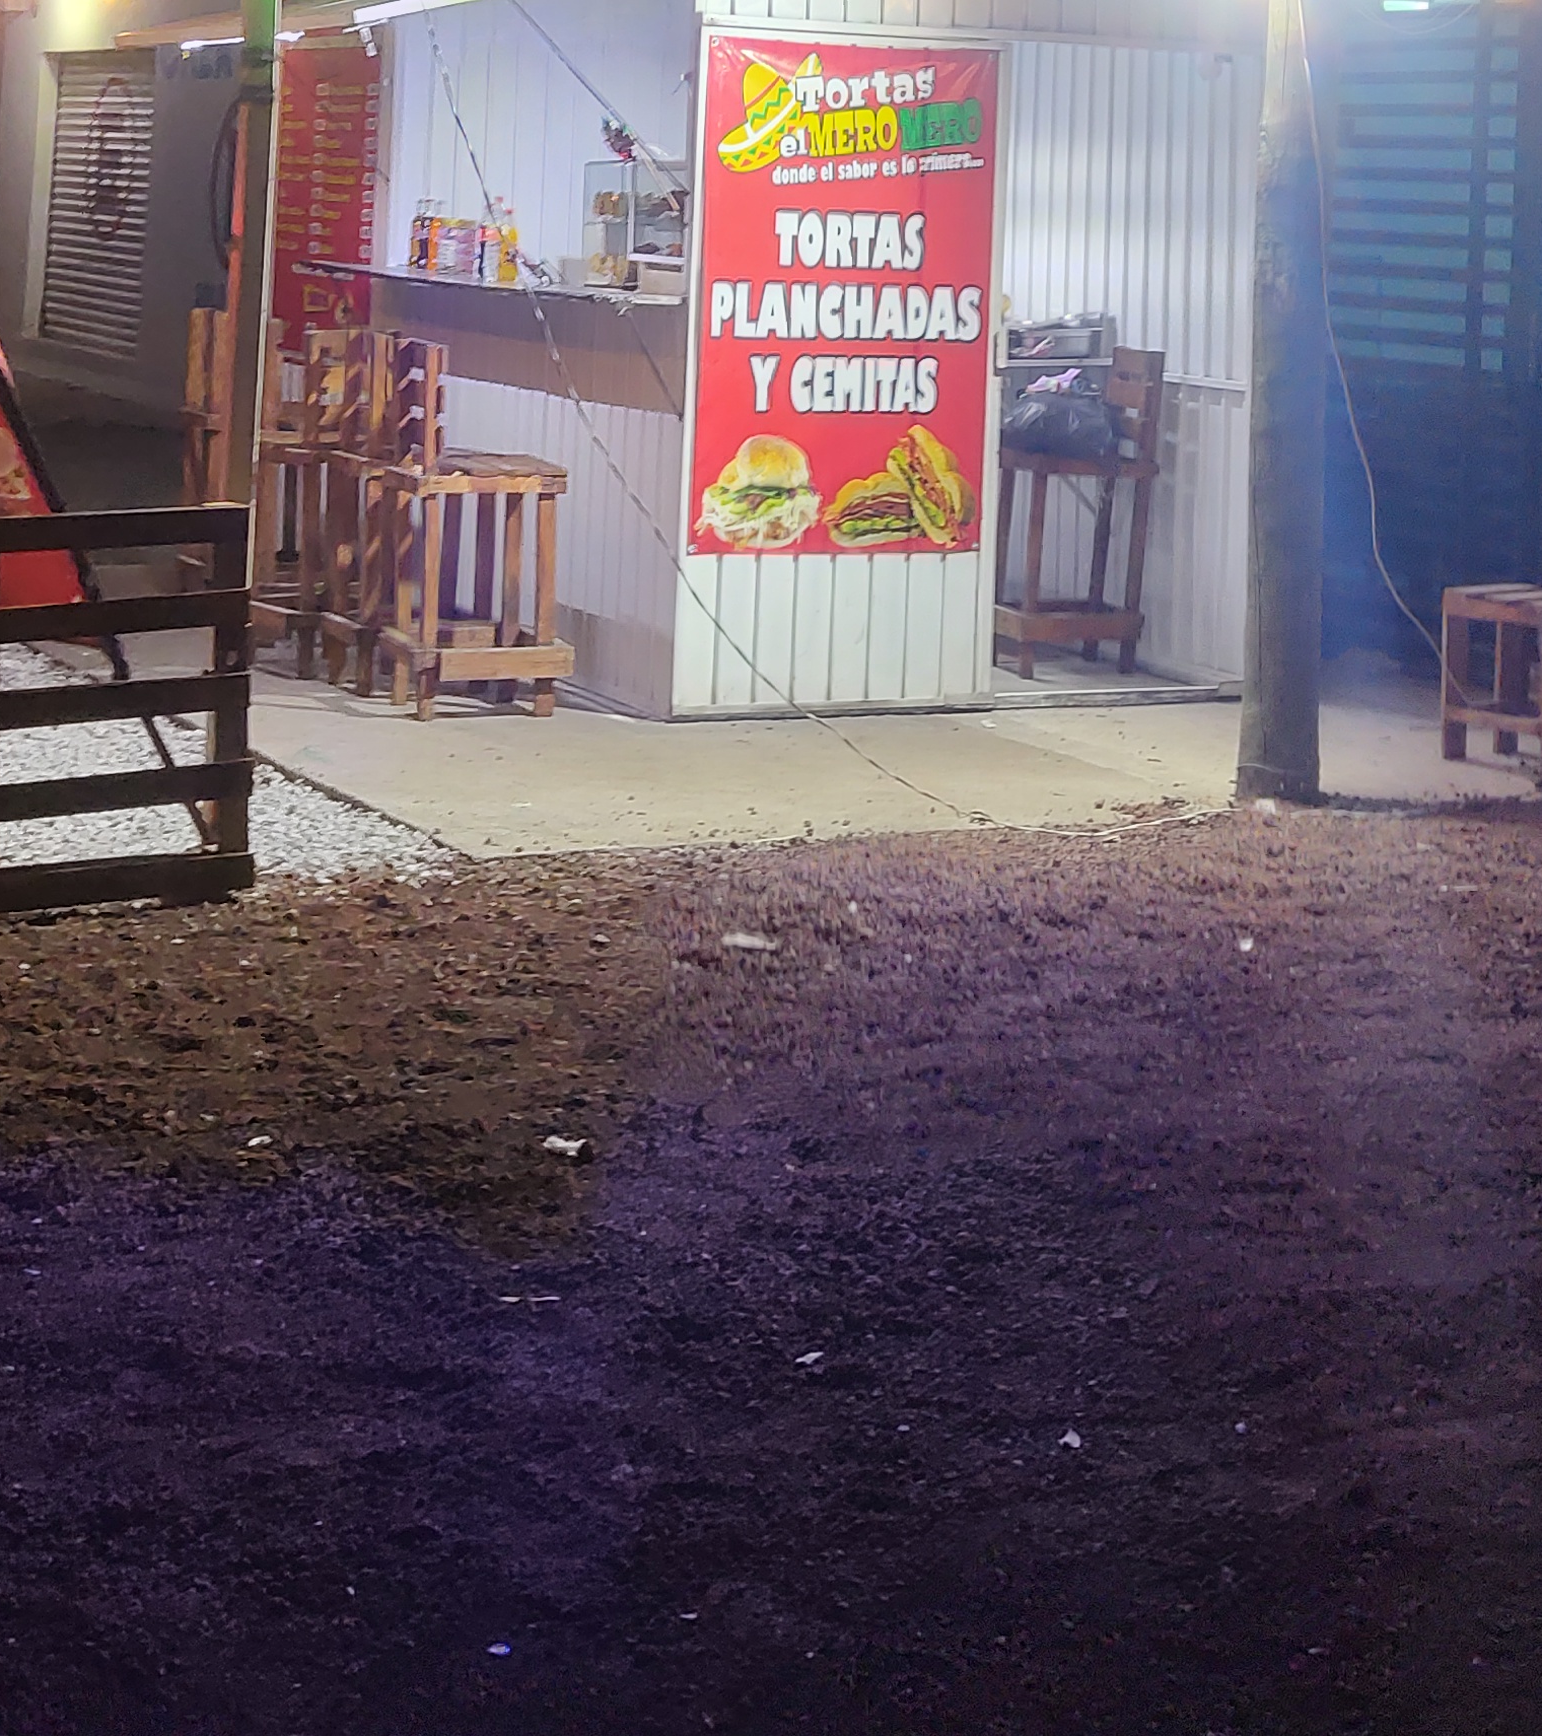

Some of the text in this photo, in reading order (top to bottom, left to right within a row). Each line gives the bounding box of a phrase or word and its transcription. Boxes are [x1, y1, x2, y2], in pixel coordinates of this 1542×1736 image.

[795, 66, 936, 113] Tortas
[779, 97, 984, 158] el MERO MERO
[771, 164, 818, 186] donde
[820, 162, 835, 182] el
[837, 158, 878, 181] sabor
[881, 158, 899, 177] es
[901, 154, 916, 175] lo
[774, 209, 926, 272] TORTAS
[709, 279, 983, 342] PLANCHADAS
[749, 353, 939, 414] Y CEMITAS
